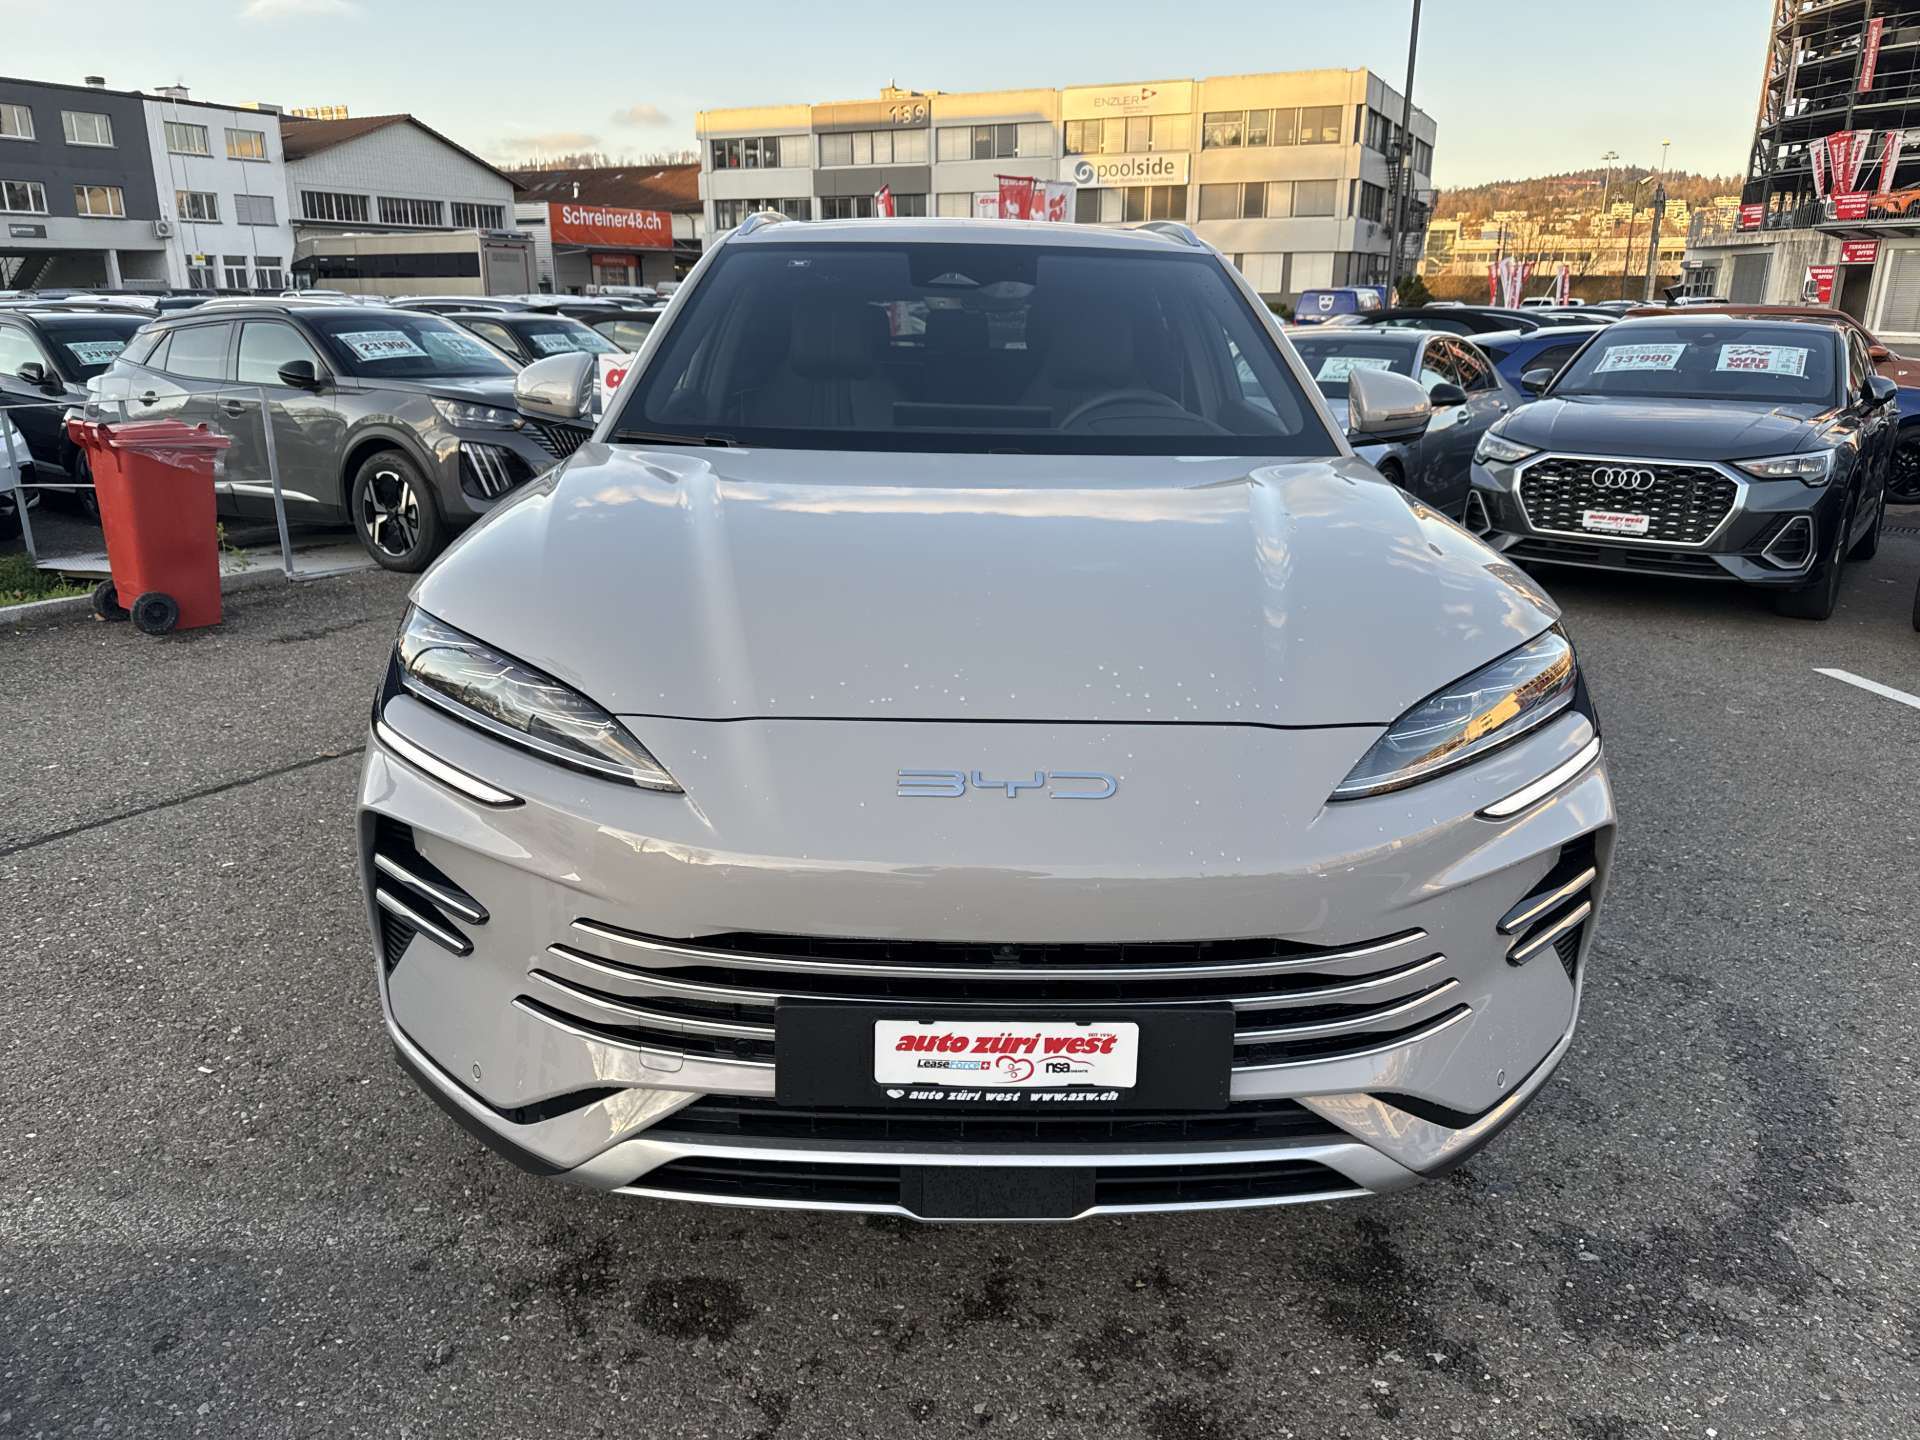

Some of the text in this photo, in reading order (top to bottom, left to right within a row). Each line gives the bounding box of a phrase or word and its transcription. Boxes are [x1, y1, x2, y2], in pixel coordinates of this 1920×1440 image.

[1094, 95, 1139, 107] ENZLER
[889, 104, 925, 123] 139
[1097, 157, 1175, 184] poolside
[562, 206, 662, 230] Schreiner48.ch
[1614, 354, 1673, 364] 33'990
[898, 768, 1118, 799] BYD
[895, 1032, 1118, 1054] auto züri west
[1045, 1062, 1070, 1074] nsa
[908, 1089, 1119, 1102] auto züri west www.azw.ch
